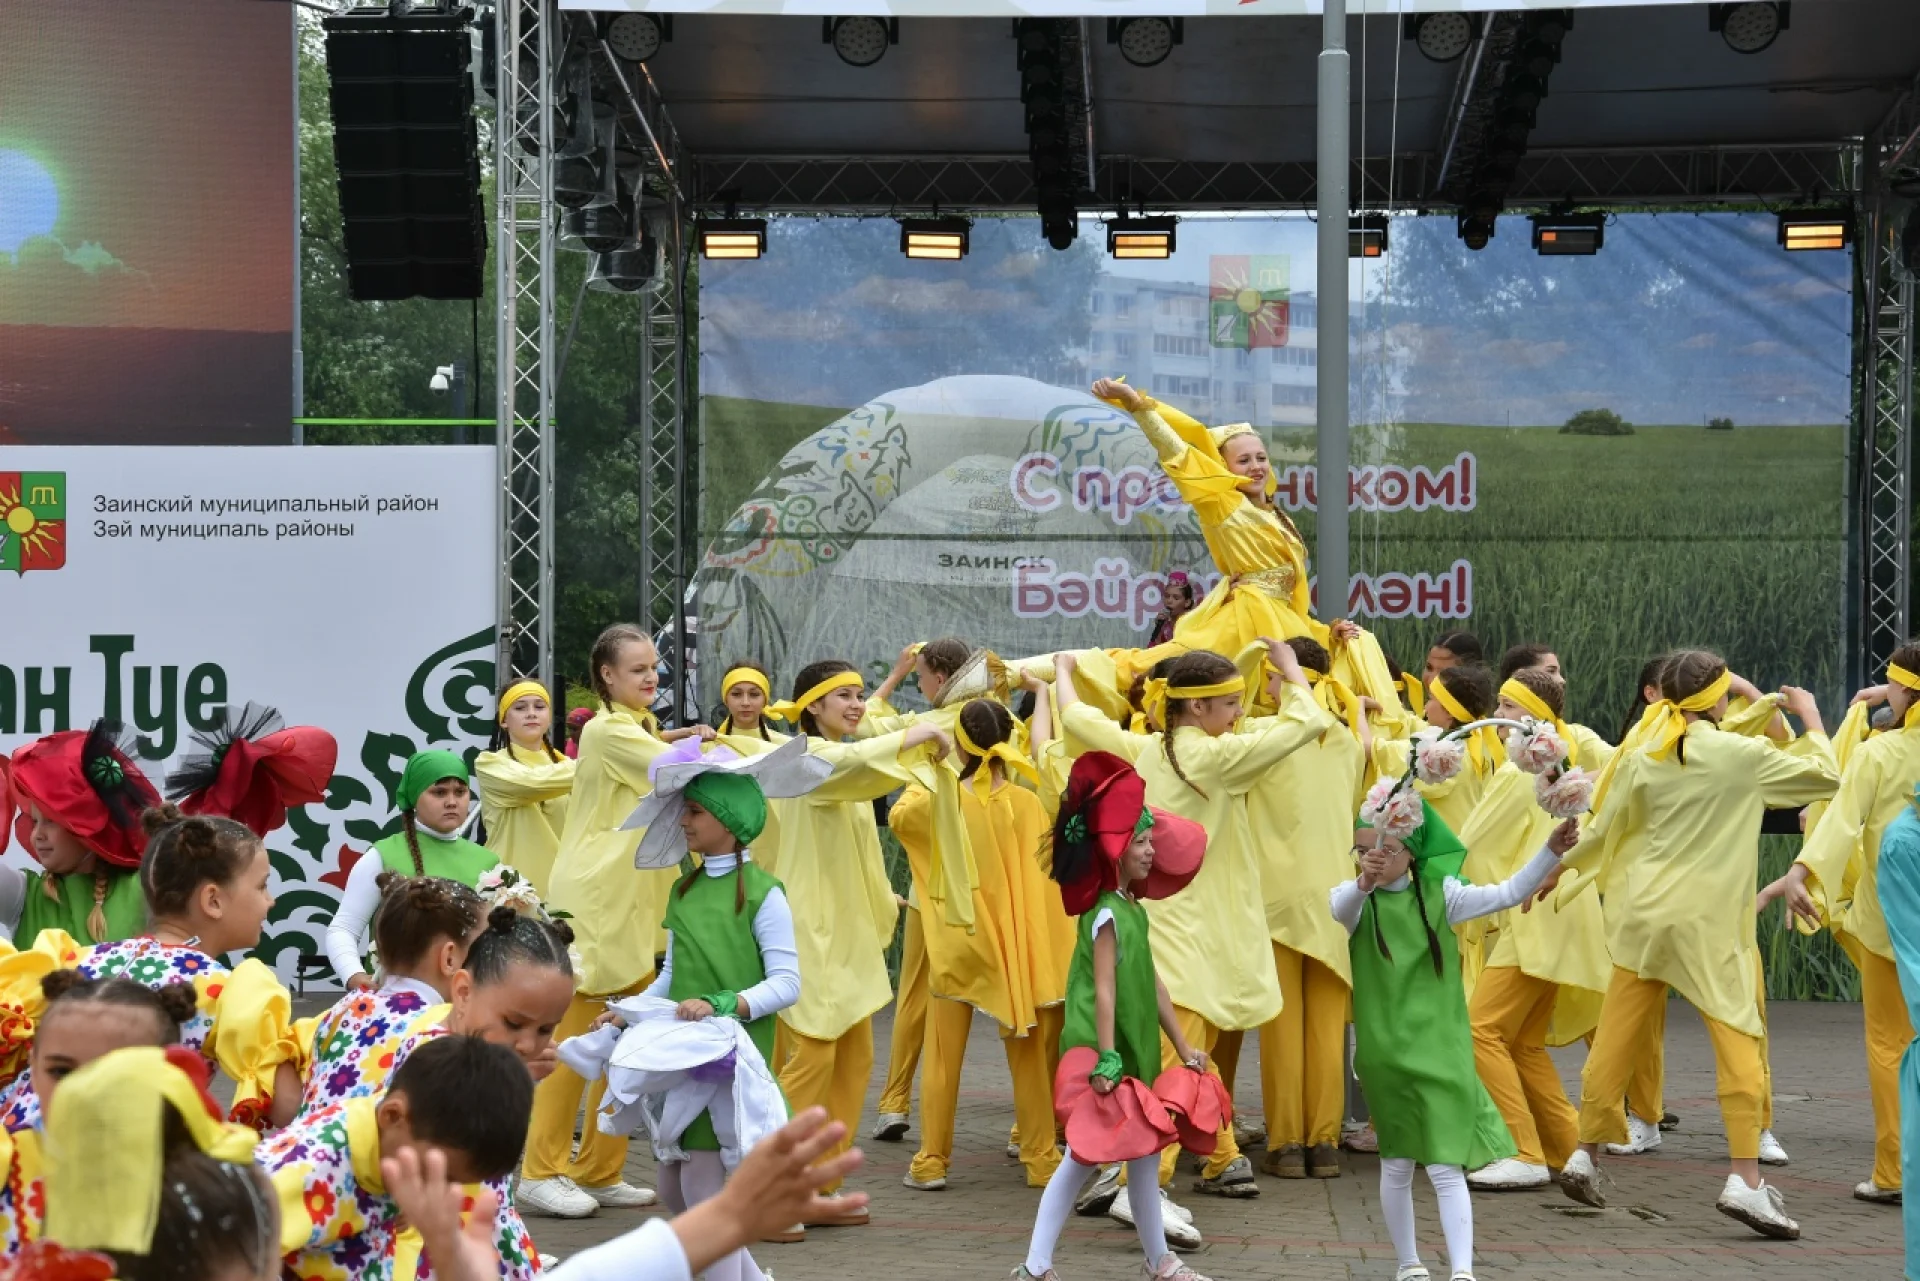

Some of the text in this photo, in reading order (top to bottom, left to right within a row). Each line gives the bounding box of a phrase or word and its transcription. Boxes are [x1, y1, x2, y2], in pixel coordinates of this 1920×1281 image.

[1014, 456, 1059, 509] С
[93, 494, 439, 516] Заинский муниципальный район
[93, 519, 354, 542] Зәй муниципаль районы
[89, 634, 228, 761] Туе
